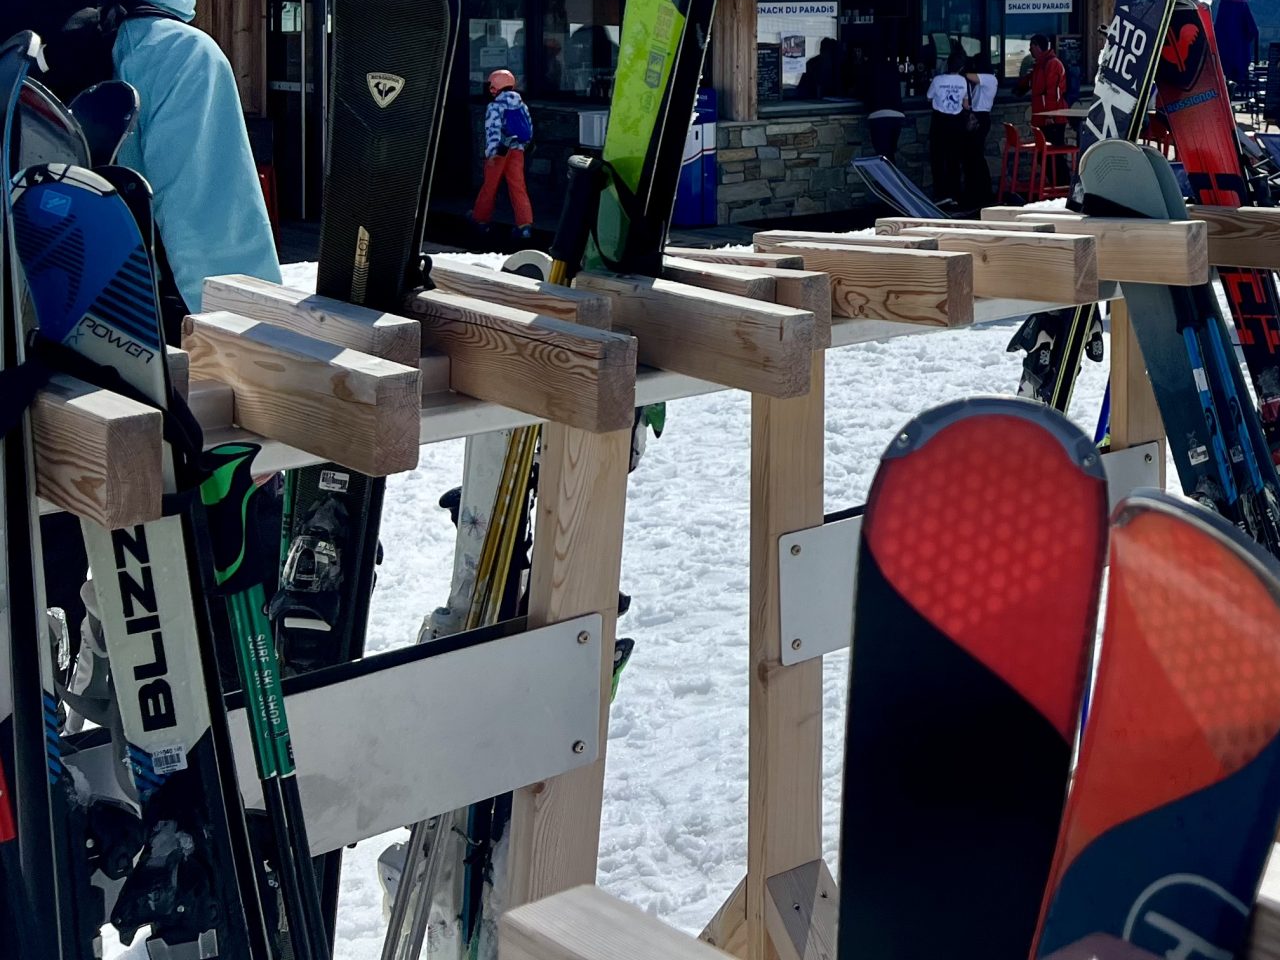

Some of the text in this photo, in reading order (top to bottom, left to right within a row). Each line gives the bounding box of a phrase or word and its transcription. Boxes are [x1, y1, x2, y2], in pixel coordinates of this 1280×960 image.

[786, 6, 797, 14] DU
[799, 5, 835, 13] PARADiS
[79, 316, 155, 364] POWER
